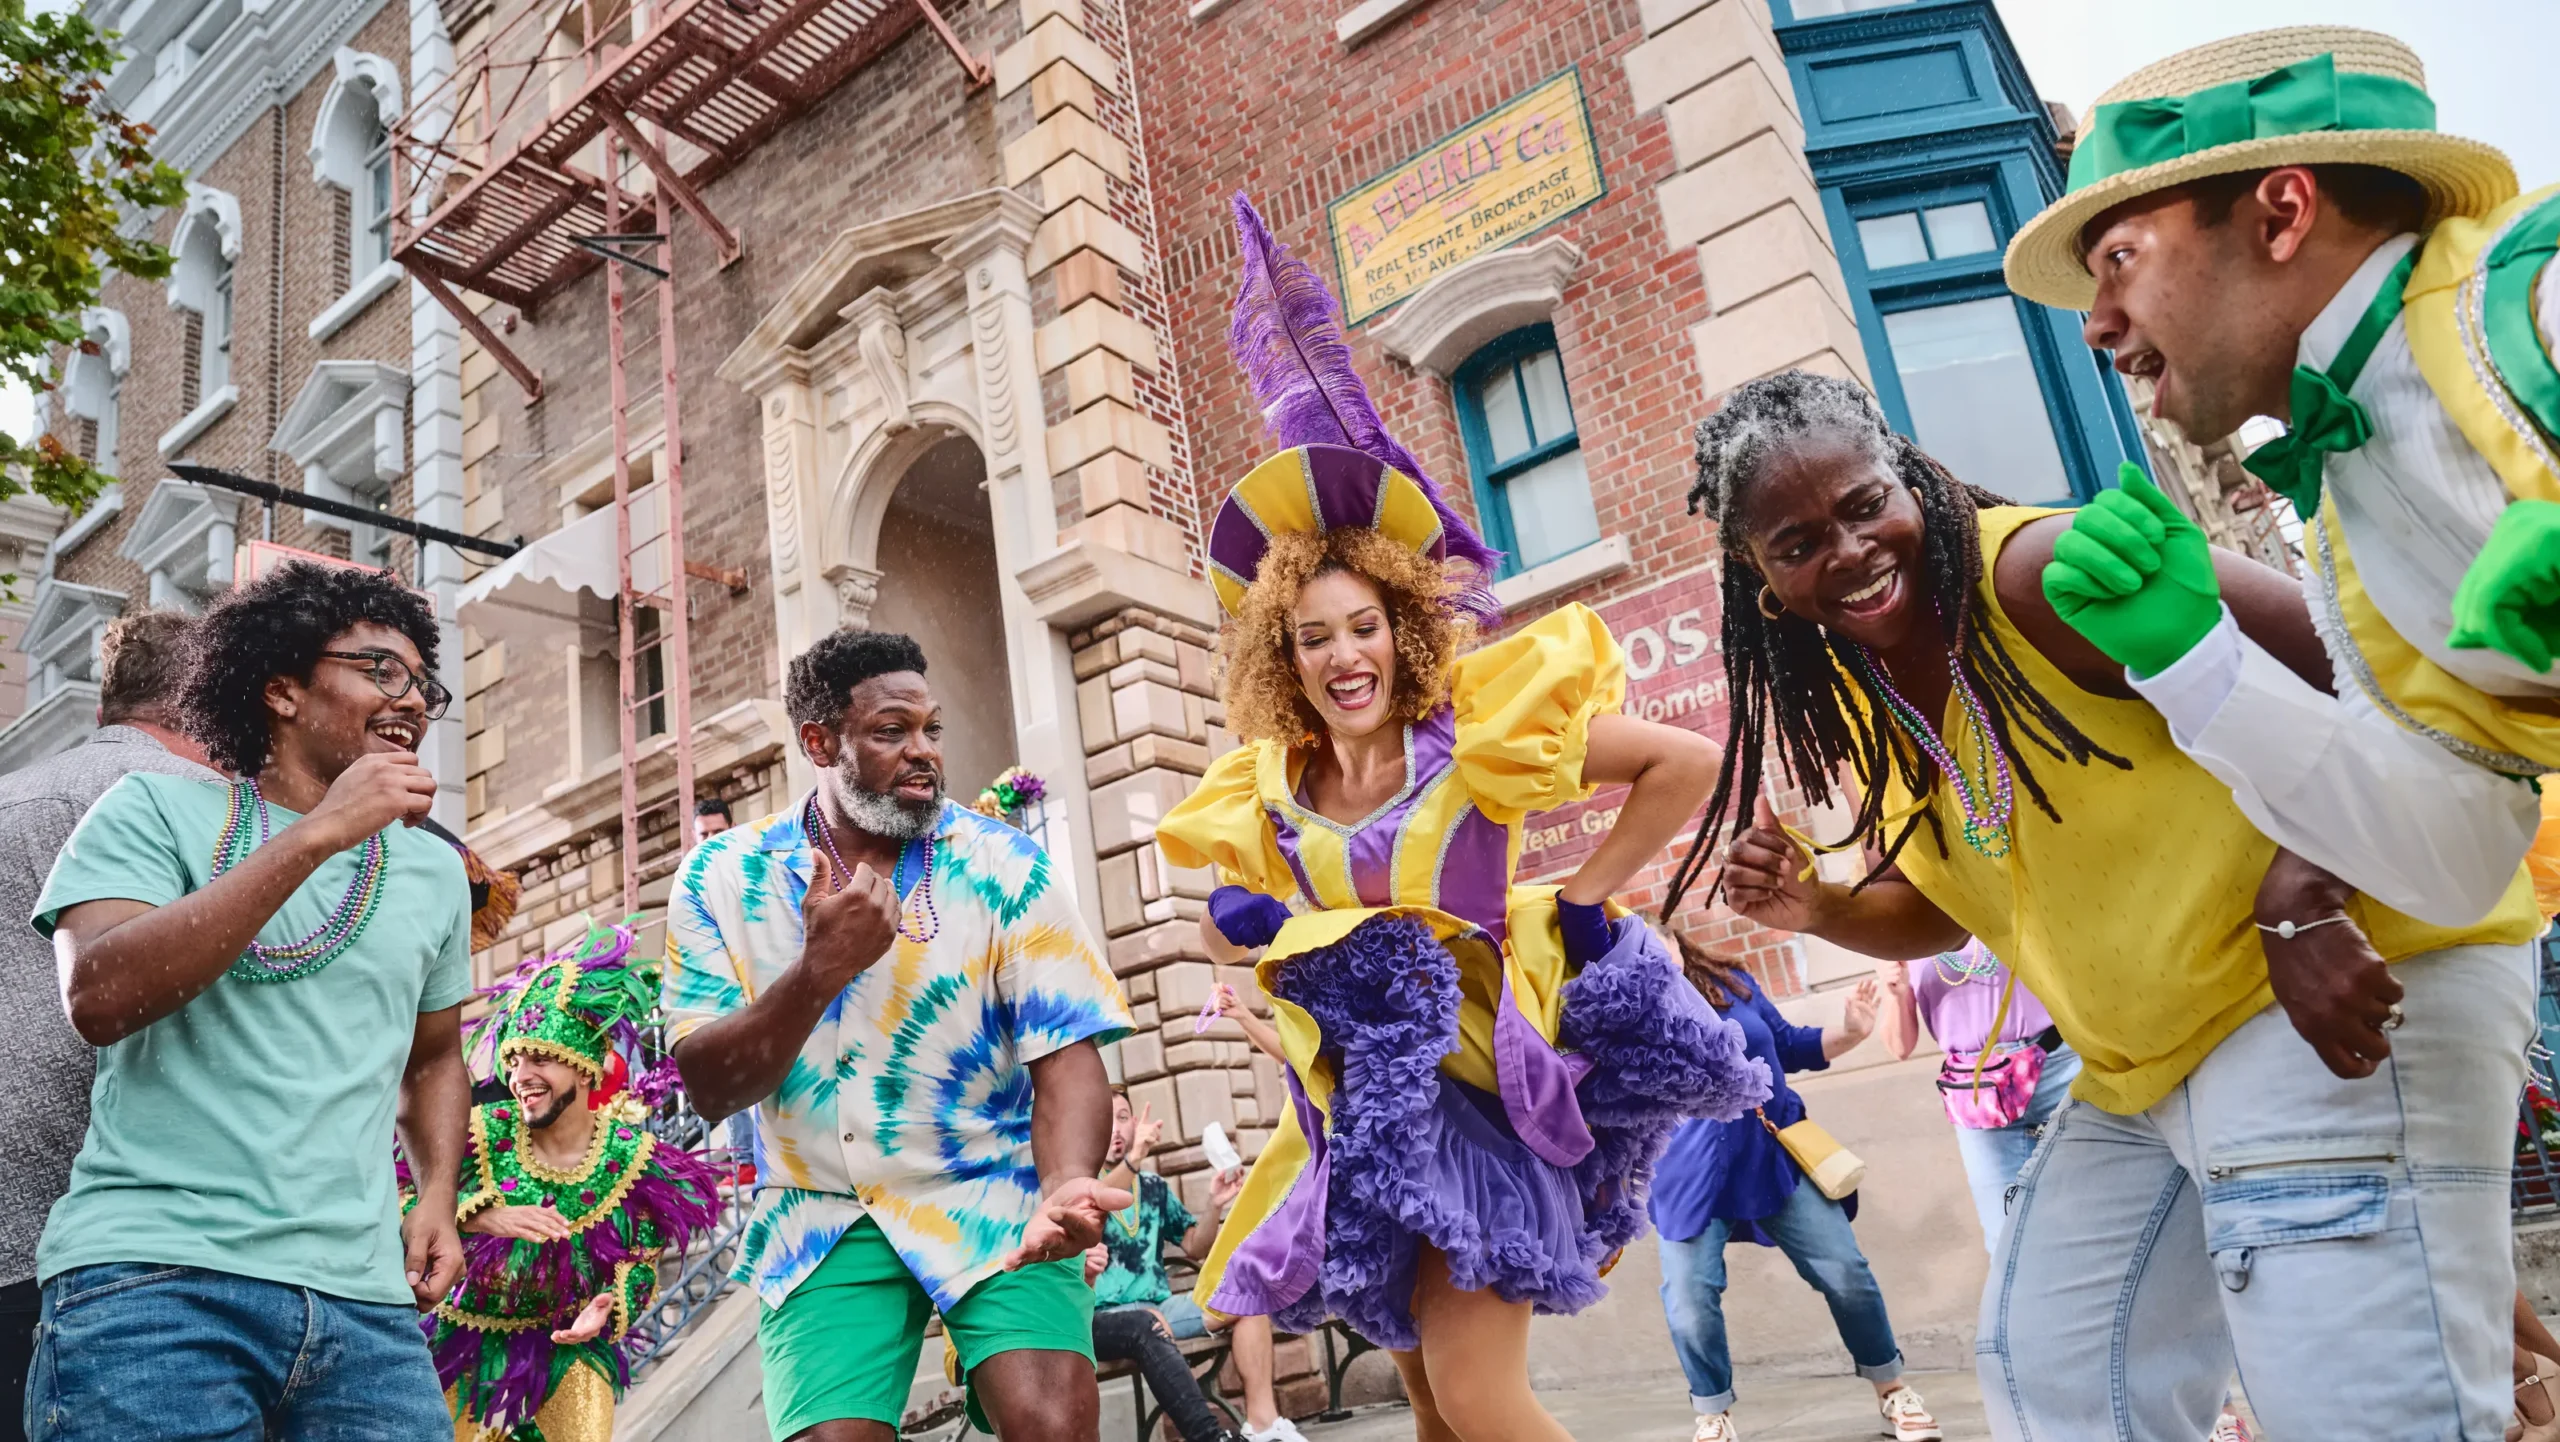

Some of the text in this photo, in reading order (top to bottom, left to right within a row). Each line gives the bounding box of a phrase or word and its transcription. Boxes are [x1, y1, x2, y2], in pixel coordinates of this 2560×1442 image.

[1347, 221, 1384, 268] A.
[1373, 124, 1512, 235] EBERLY
[1365, 166, 1569, 286] REAL ESTATE BROKERAGE
[1369, 281, 1397, 305] 105
[1473, 210, 1537, 251] JAMAICA
[1520, 823, 1572, 855] ear
